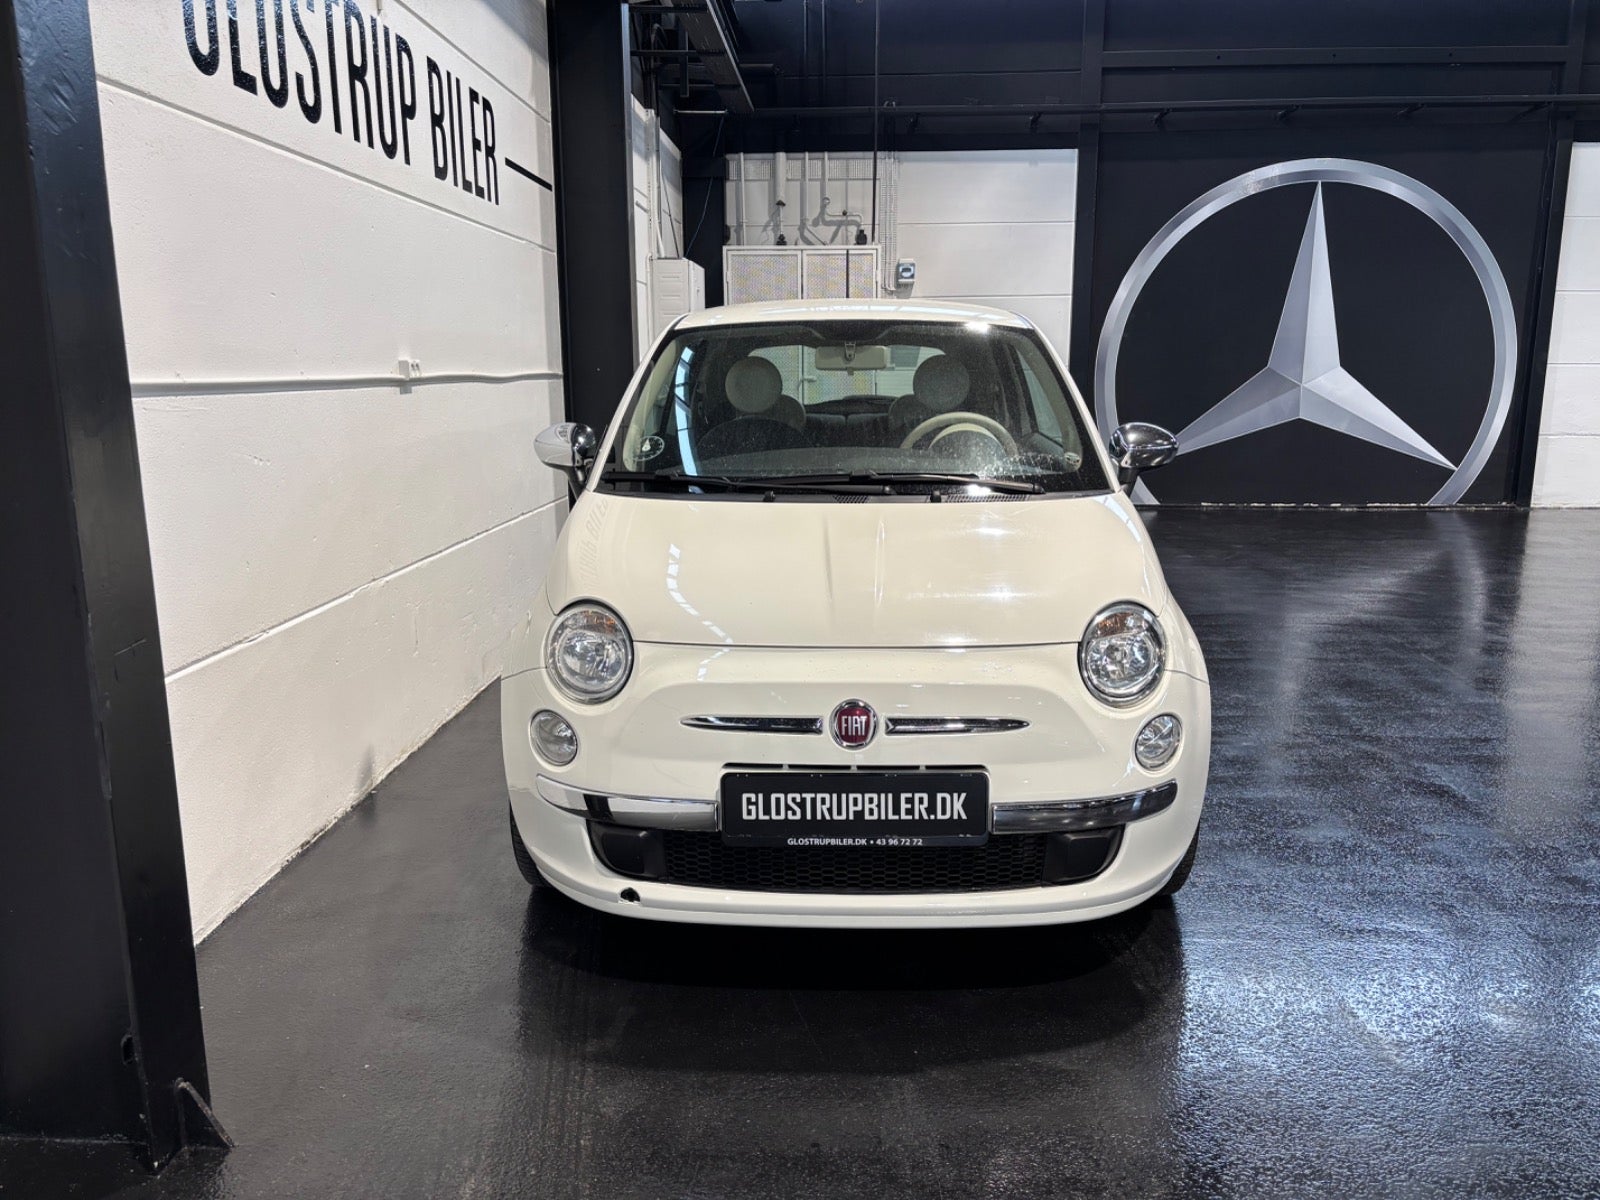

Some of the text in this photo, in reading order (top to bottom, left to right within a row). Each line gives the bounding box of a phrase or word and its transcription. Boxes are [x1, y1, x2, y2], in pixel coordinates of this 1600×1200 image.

[427, 55, 499, 206] BILER
[841, 715, 868, 736] FIAT
[742, 792, 967, 820] GLOSTRUPBILER.DK
[787, 838, 923, 846] GLOSTRUPBILER.DK 43 96 72 72
